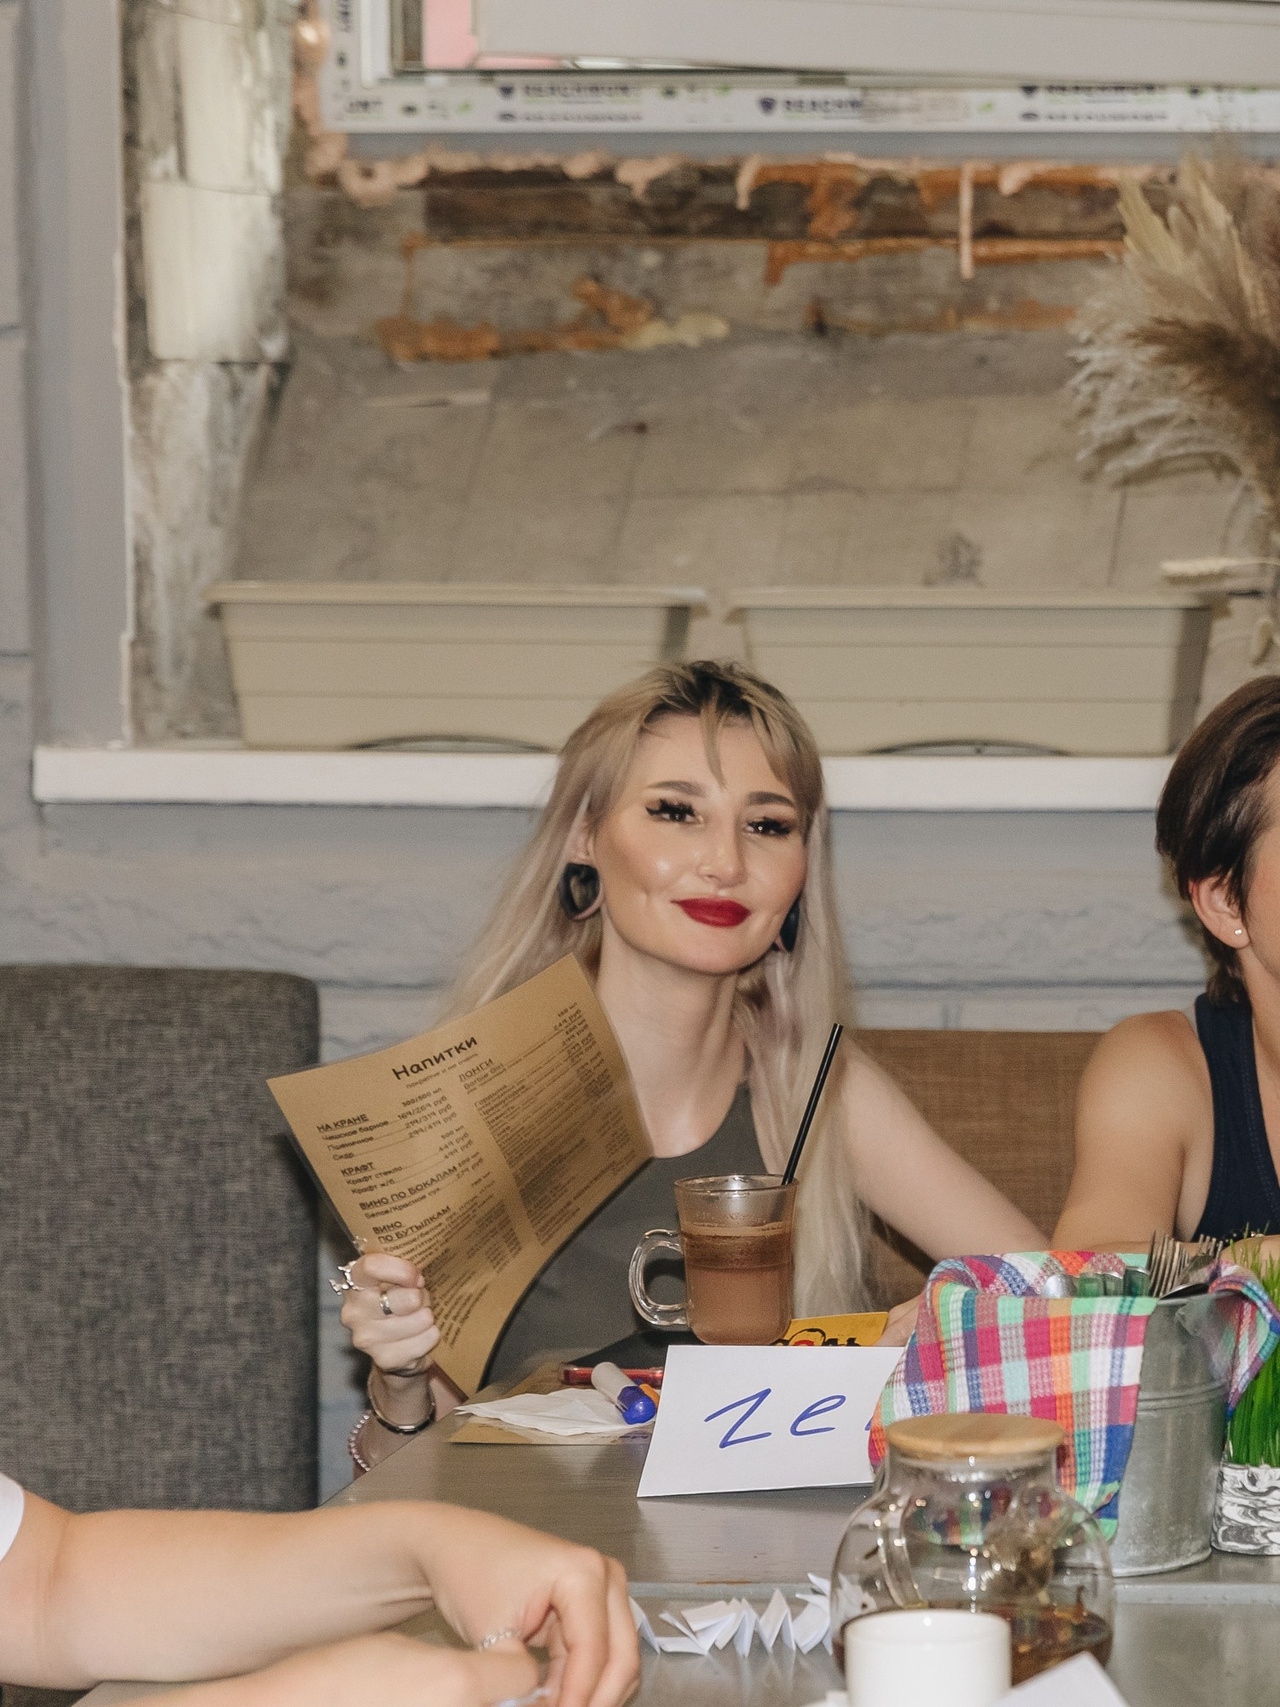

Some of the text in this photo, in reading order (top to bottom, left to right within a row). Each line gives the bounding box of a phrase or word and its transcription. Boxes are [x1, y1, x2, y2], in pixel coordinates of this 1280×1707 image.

[392, 1035, 478, 1081] Напитки
[459, 1059, 493, 1083] ЛОНГИ
[432, 1095, 448, 1106] руб
[436, 1102, 453, 1115] руб
[316, 1113, 368, 1133] НА КРАНЕ
[441, 1111, 458, 1123] руб
[340, 1161, 375, 1177] КРАФТ
[358, 1196, 389, 1211] ВИНО
[390, 1188, 407, 1203] ПО
[407, 1165, 458, 1195] БОКАЛАМ
[372, 1219, 403, 1234] ВИНО
[377, 1204, 451, 1243] ПО БУТЫЛКАМ
[703, 1387, 872, 1449] Ze
